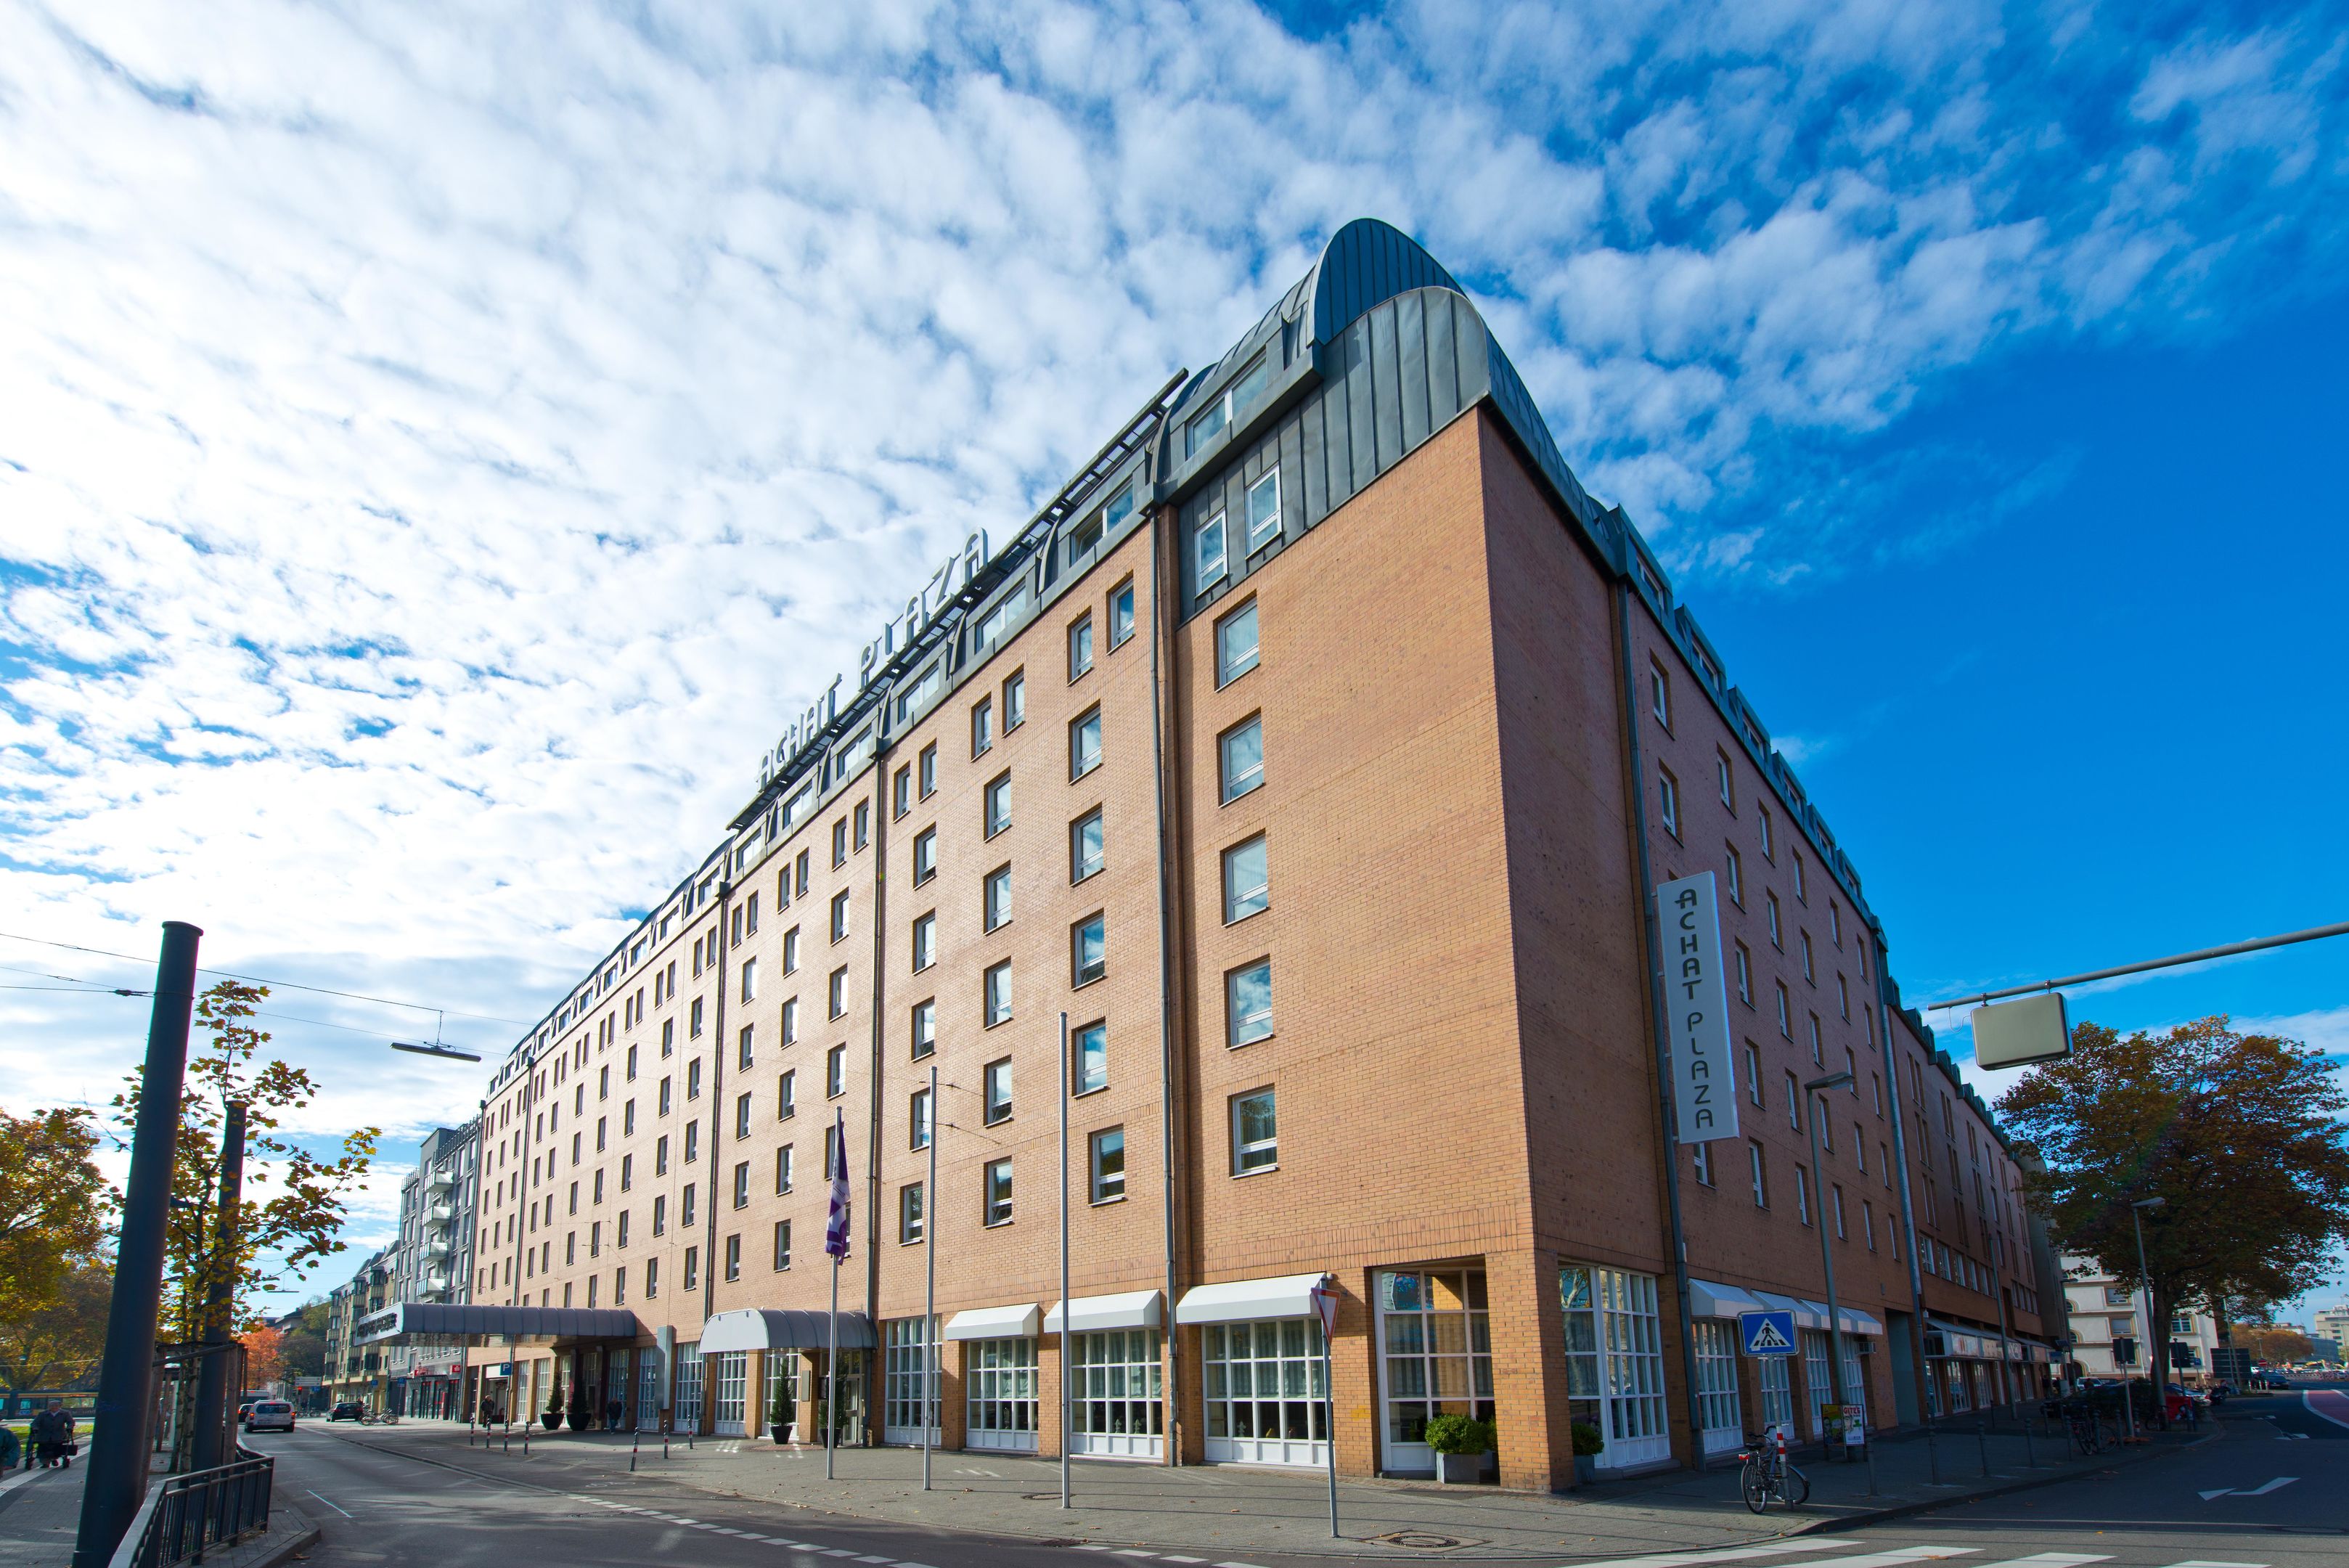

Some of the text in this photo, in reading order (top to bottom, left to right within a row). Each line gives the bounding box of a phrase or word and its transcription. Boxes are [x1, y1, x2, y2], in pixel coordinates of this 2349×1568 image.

[755, 526, 988, 793] ACHAT PLAZA
[1674, 889, 1714, 1130] ACHAT PLAZA
